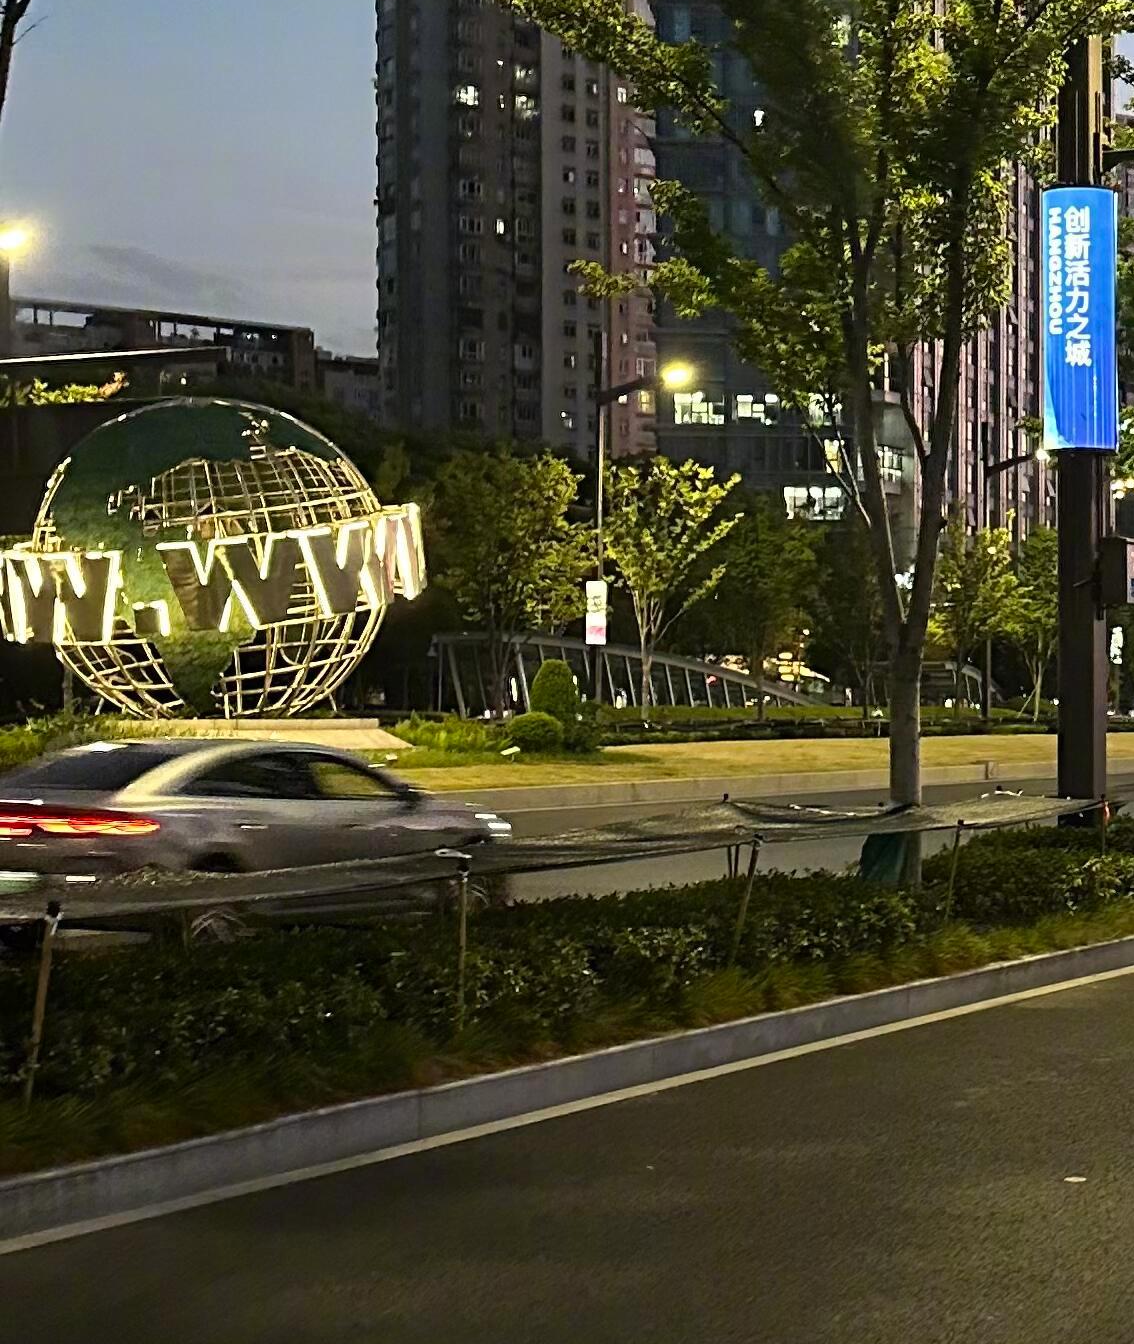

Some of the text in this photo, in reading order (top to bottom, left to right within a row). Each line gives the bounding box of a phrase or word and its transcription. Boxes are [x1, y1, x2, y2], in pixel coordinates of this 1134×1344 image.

[1048, 207, 1063, 335] HANGZHOU
[1064, 206, 1093, 367] 创新活力之城
